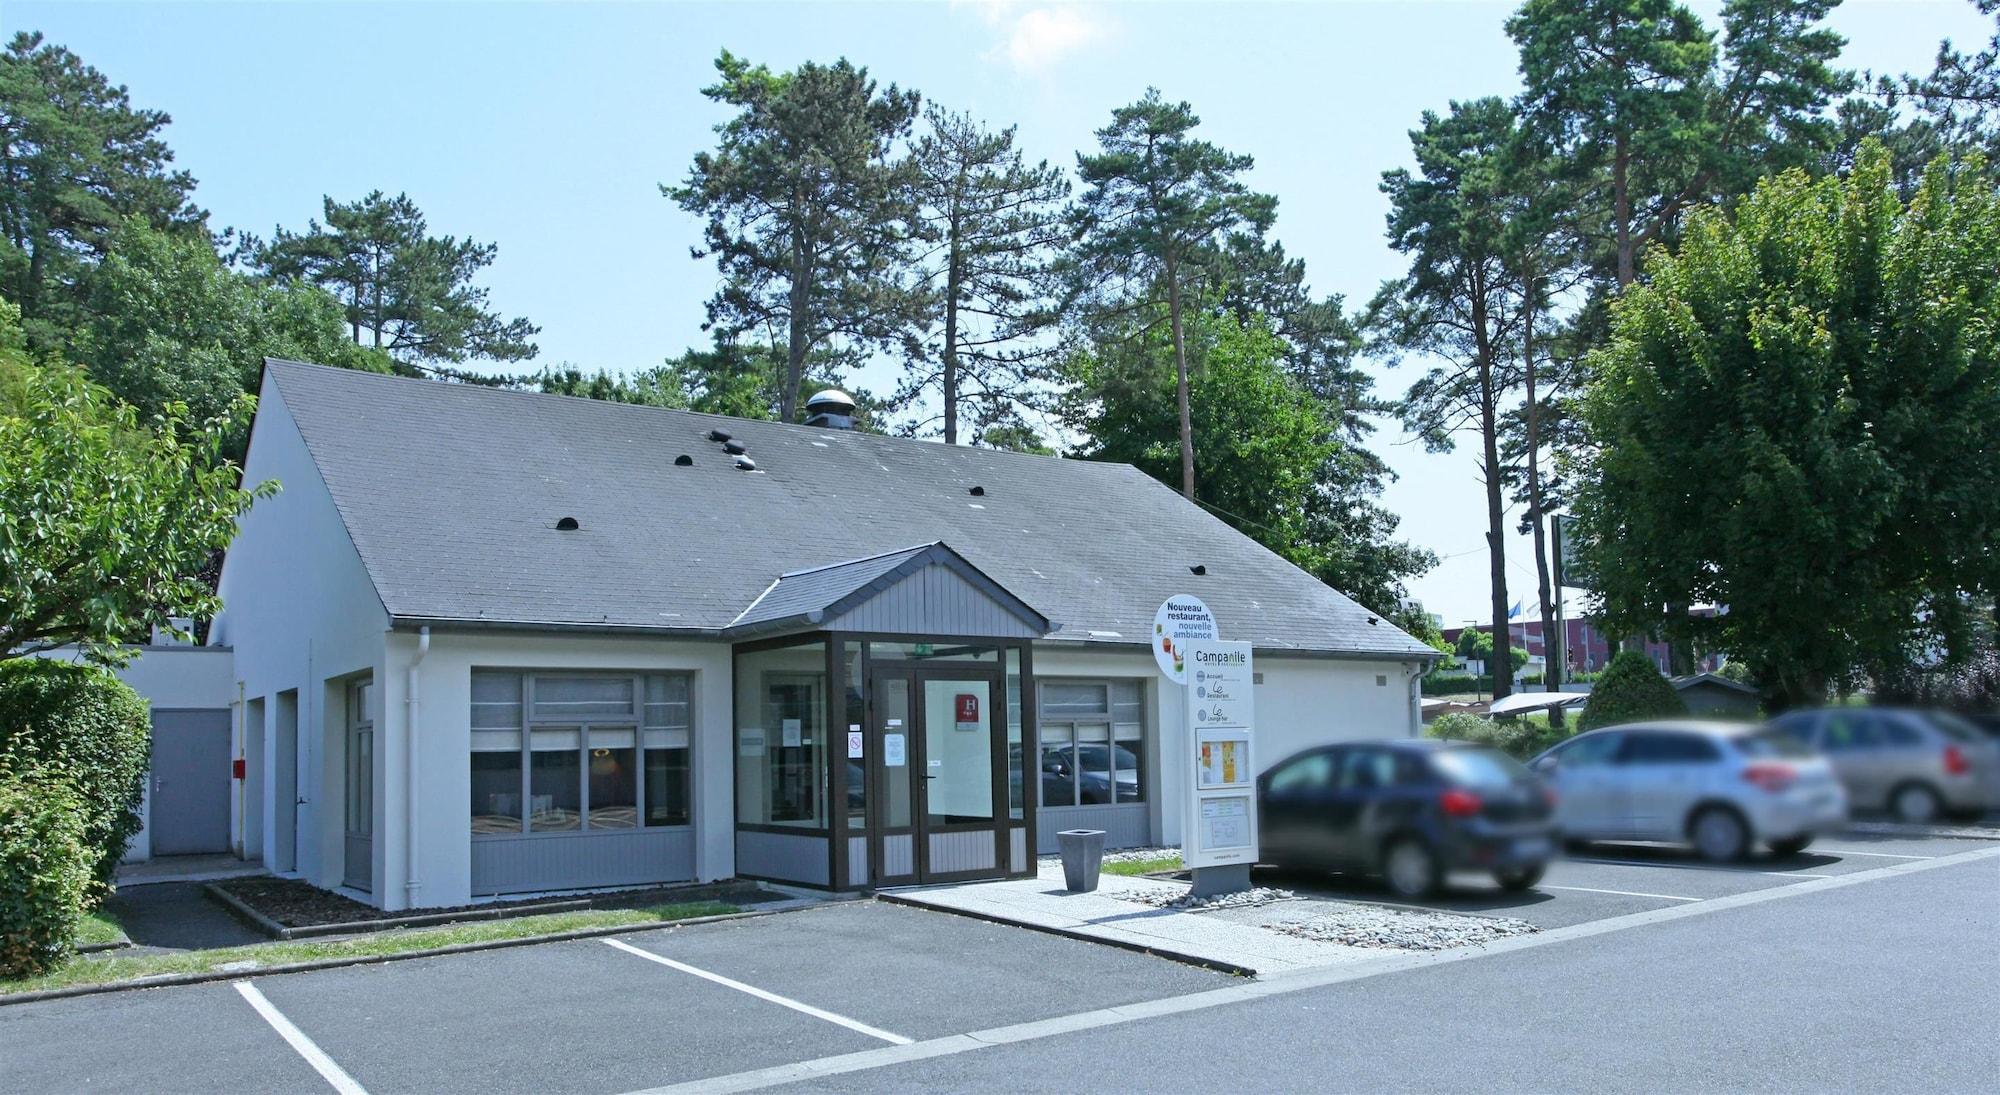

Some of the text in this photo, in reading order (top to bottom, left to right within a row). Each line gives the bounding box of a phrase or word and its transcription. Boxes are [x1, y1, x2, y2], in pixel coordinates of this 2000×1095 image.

[1167, 602, 1202, 612] Nouveau
[1167, 612, 1211, 622] restaurant,
[1178, 622, 1212, 631] nouvelle
[1173, 630, 1212, 639] ambiance
[1196, 650, 1246, 666] Campanile
[1212, 680, 1223, 694] Le
[966, 699, 976, 711] H
[1212, 703, 1223, 717] Le
